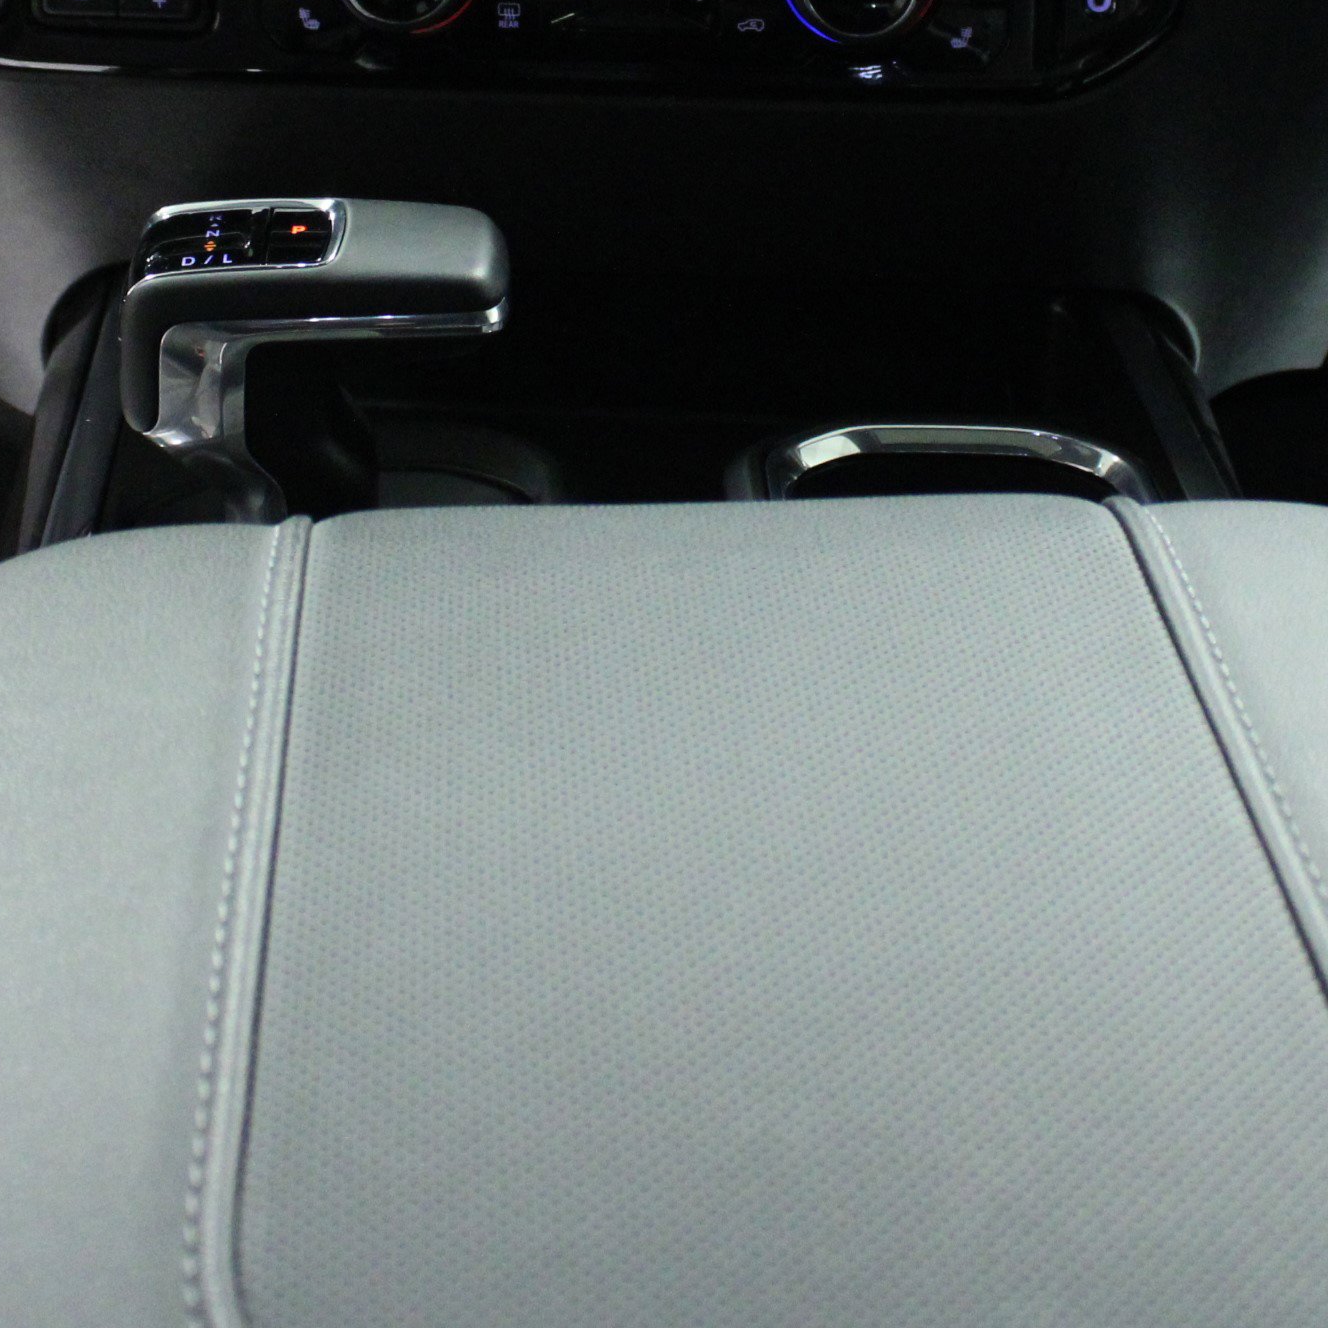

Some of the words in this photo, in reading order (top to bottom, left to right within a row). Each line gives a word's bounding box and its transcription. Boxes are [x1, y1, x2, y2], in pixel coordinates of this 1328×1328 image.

[498, 19, 520, 29] REAR
[291, 225, 306, 234] P
[181, 256, 196, 266] D
[223, 254, 232, 263] L
